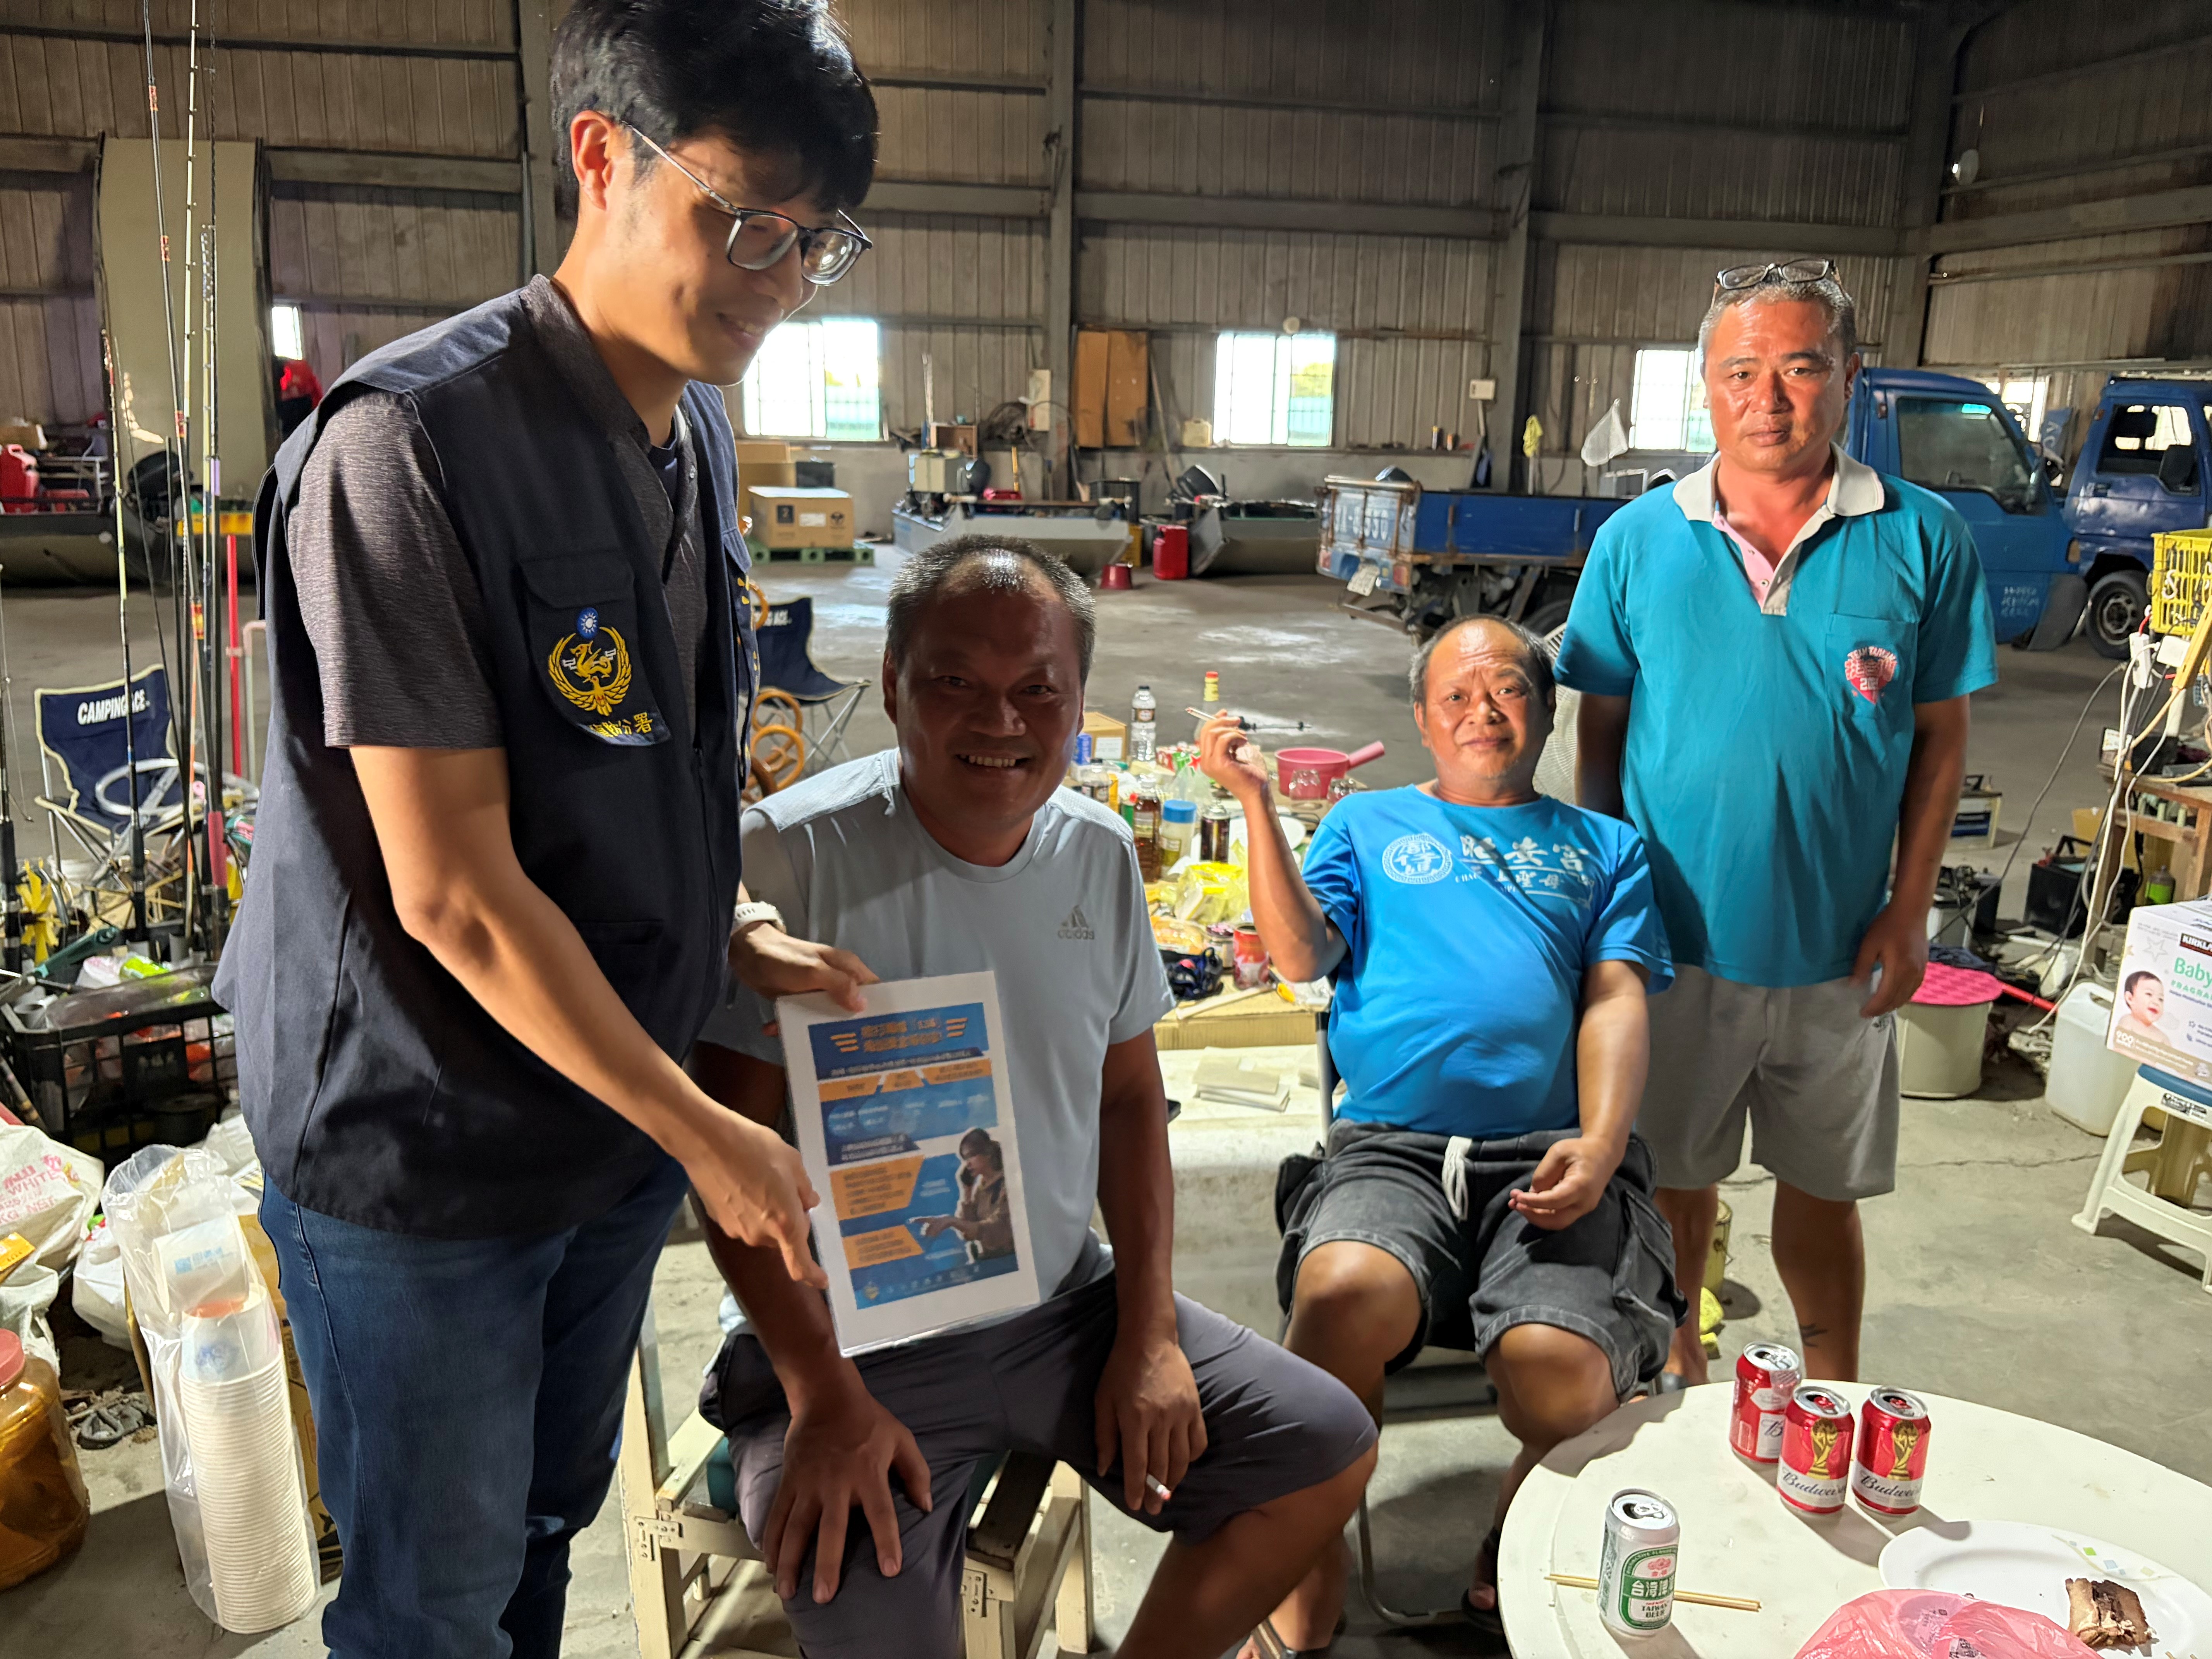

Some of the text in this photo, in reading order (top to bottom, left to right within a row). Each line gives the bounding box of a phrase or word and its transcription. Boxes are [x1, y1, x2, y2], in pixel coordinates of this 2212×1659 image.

[77, 694, 129, 725] CAMPING
[2182, 934, 2212, 950] KIRKLA
[2171, 980, 2212, 1001] FRAGRA
